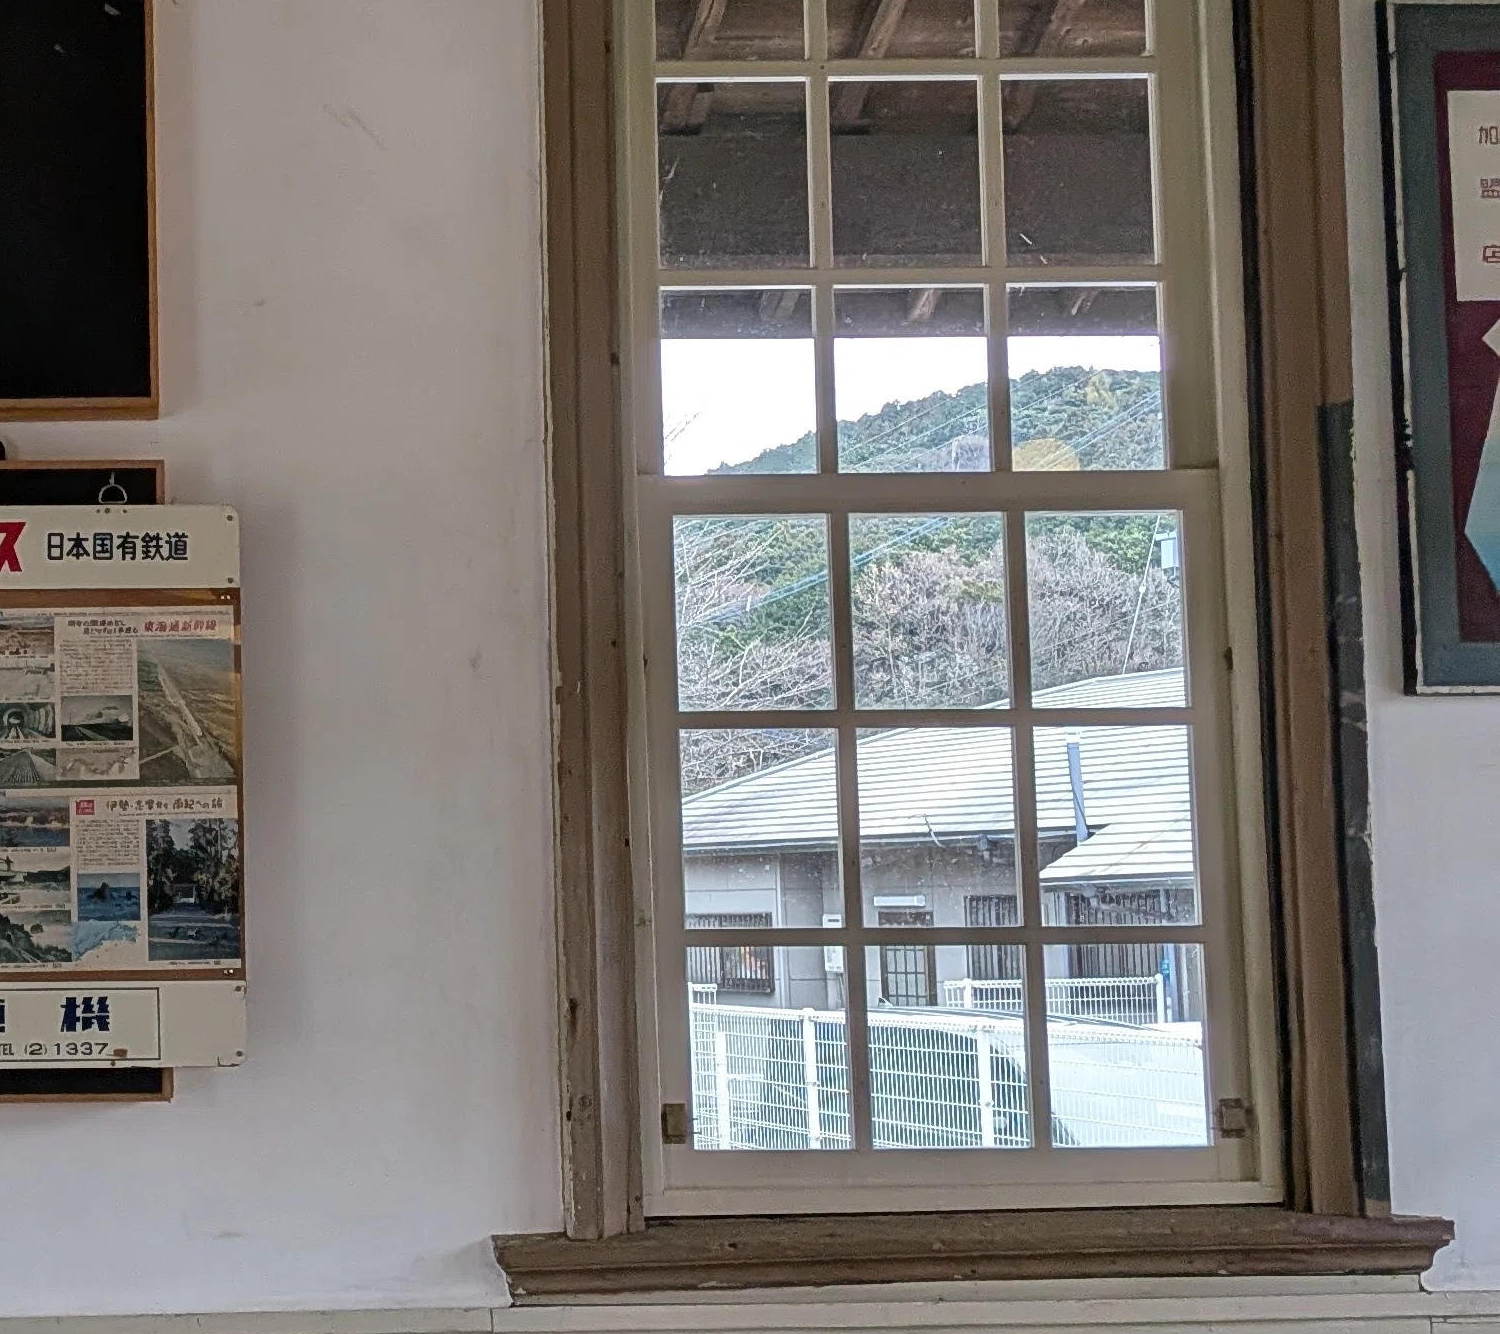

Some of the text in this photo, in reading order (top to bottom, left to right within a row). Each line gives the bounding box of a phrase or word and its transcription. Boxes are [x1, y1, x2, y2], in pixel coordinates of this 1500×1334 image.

[46, 532, 189, 562] 日本国有鉄道
